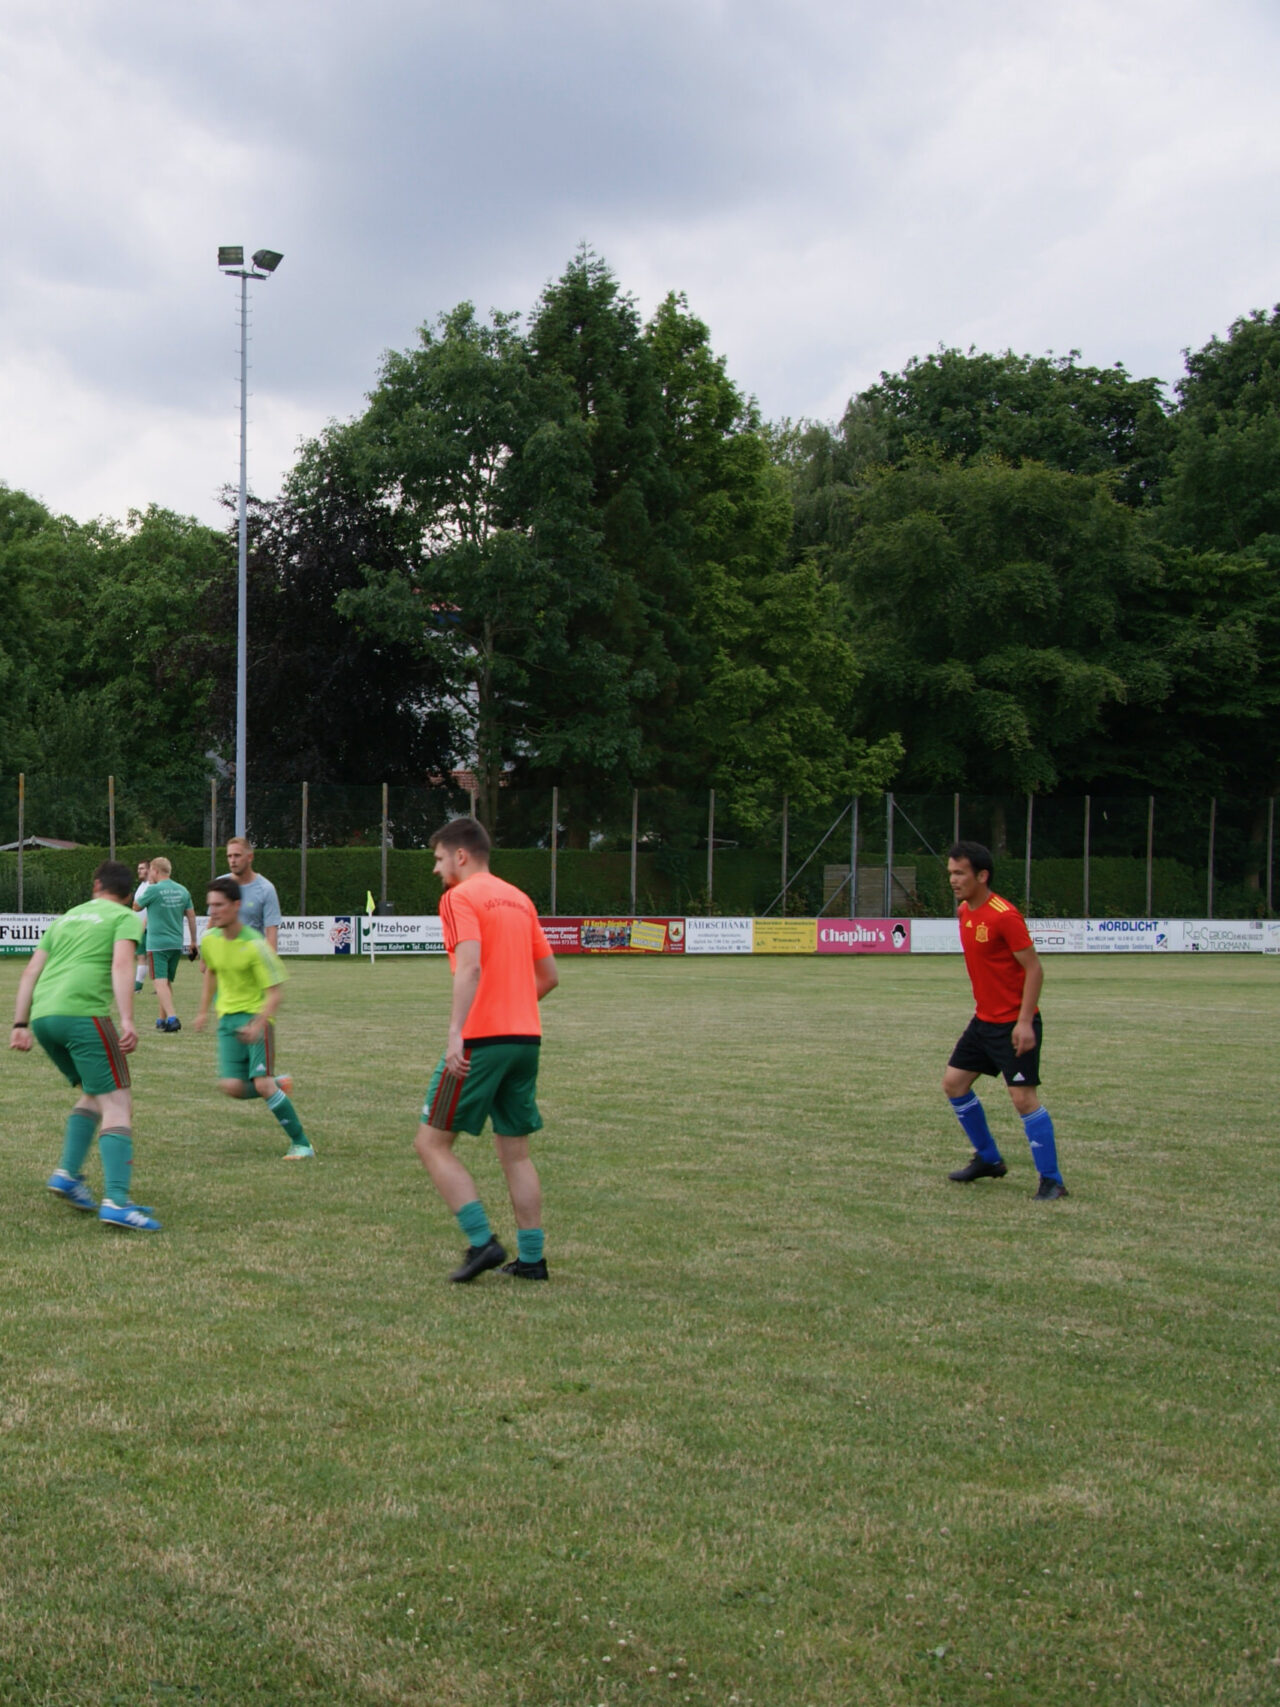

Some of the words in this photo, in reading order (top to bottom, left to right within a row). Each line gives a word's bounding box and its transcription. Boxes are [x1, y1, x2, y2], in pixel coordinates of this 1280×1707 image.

[276, 921, 295, 929] AM
[298, 921, 324, 930] ROSE
[377, 922, 421, 933] Itzehoer
[1099, 921, 1158, 931] NORDLICHT
[820, 924, 885, 946] Chaplin's
